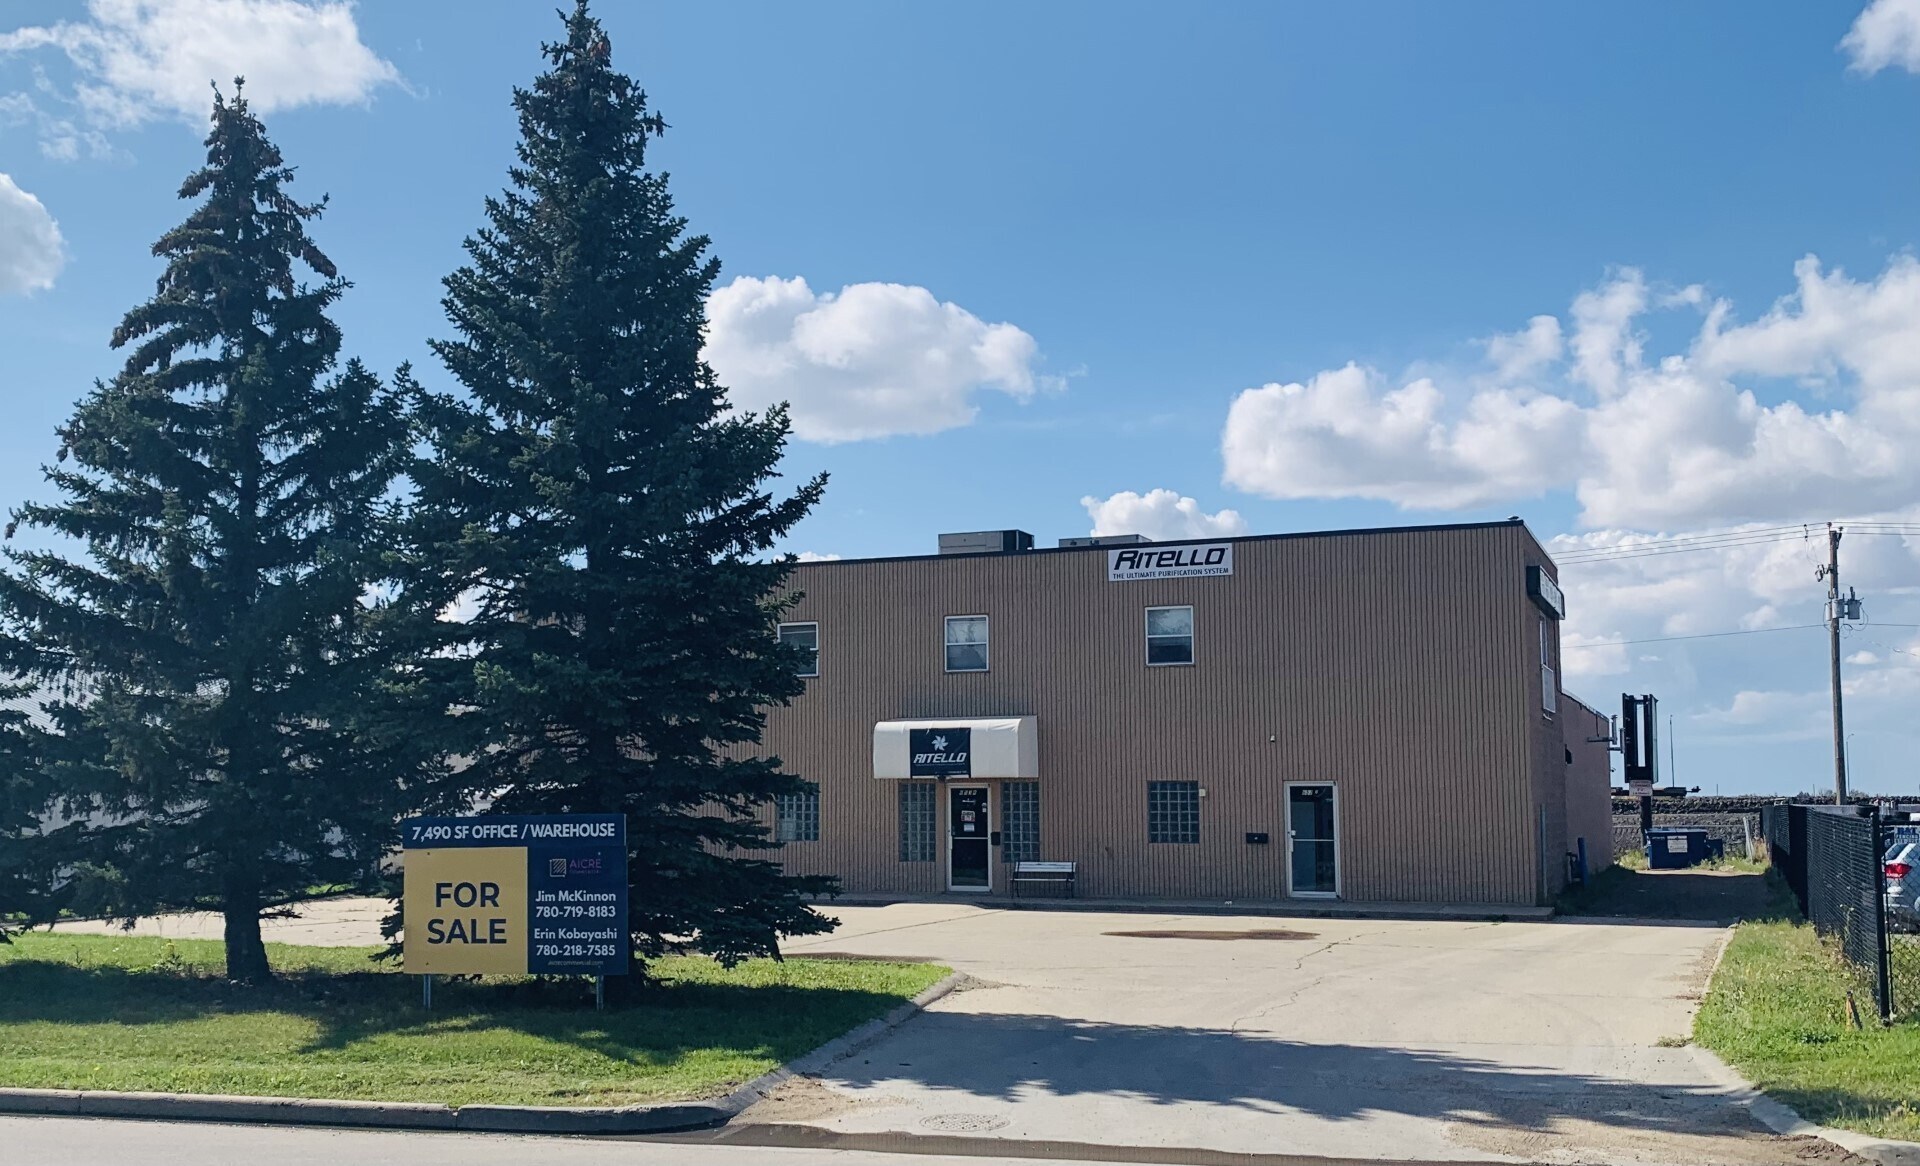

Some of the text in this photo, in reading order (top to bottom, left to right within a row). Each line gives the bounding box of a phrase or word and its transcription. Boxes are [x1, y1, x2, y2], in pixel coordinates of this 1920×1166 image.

[1126, 571, 1157, 579] ULTIMATE
[1158, 569, 1203, 577] PURIFICATION
[1204, 567, 1229, 575] SYSTEM
[913, 752, 967, 764] RITELLO
[412, 825, 452, 842] 7,490
[454, 826, 470, 839] SF
[472, 825, 518, 839] OFFICE
[530, 823, 615, 838] WAREHOUSE
[569, 859, 602, 869] AICRE
[435, 882, 500, 908] FOR
[535, 890, 617, 902] Jim McKinnon
[535, 905, 616, 918] 780-719-8183
[427, 918, 508, 945] SALE
[534, 928, 618, 943] Erin Kobayashi
[536, 944, 616, 956] 780-218-7585
